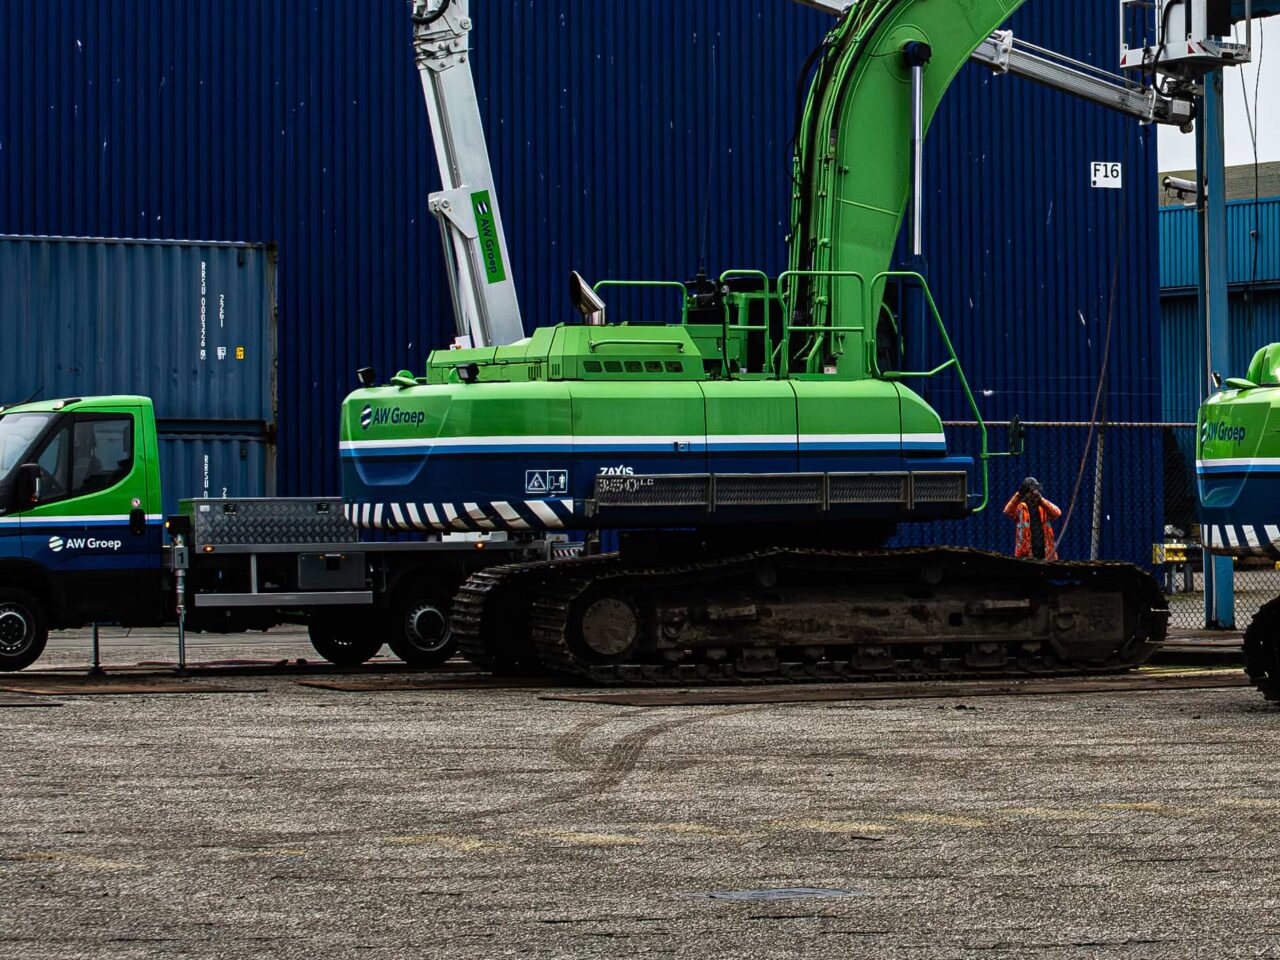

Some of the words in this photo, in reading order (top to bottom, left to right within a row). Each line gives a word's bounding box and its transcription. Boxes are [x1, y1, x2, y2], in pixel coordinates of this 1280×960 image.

[1093, 162, 1120, 179] F16
[480, 218, 491, 237] AW
[485, 239, 497, 274] Groep
[372, 407, 391, 425] AW
[391, 406, 425, 428] Groep
[1218, 421, 1246, 447] Groep
[600, 464, 634, 476] ZAXIS
[66, 538, 86, 549] AW
[87, 537, 122, 551] Groep
[178, 551, 185, 564] 1
